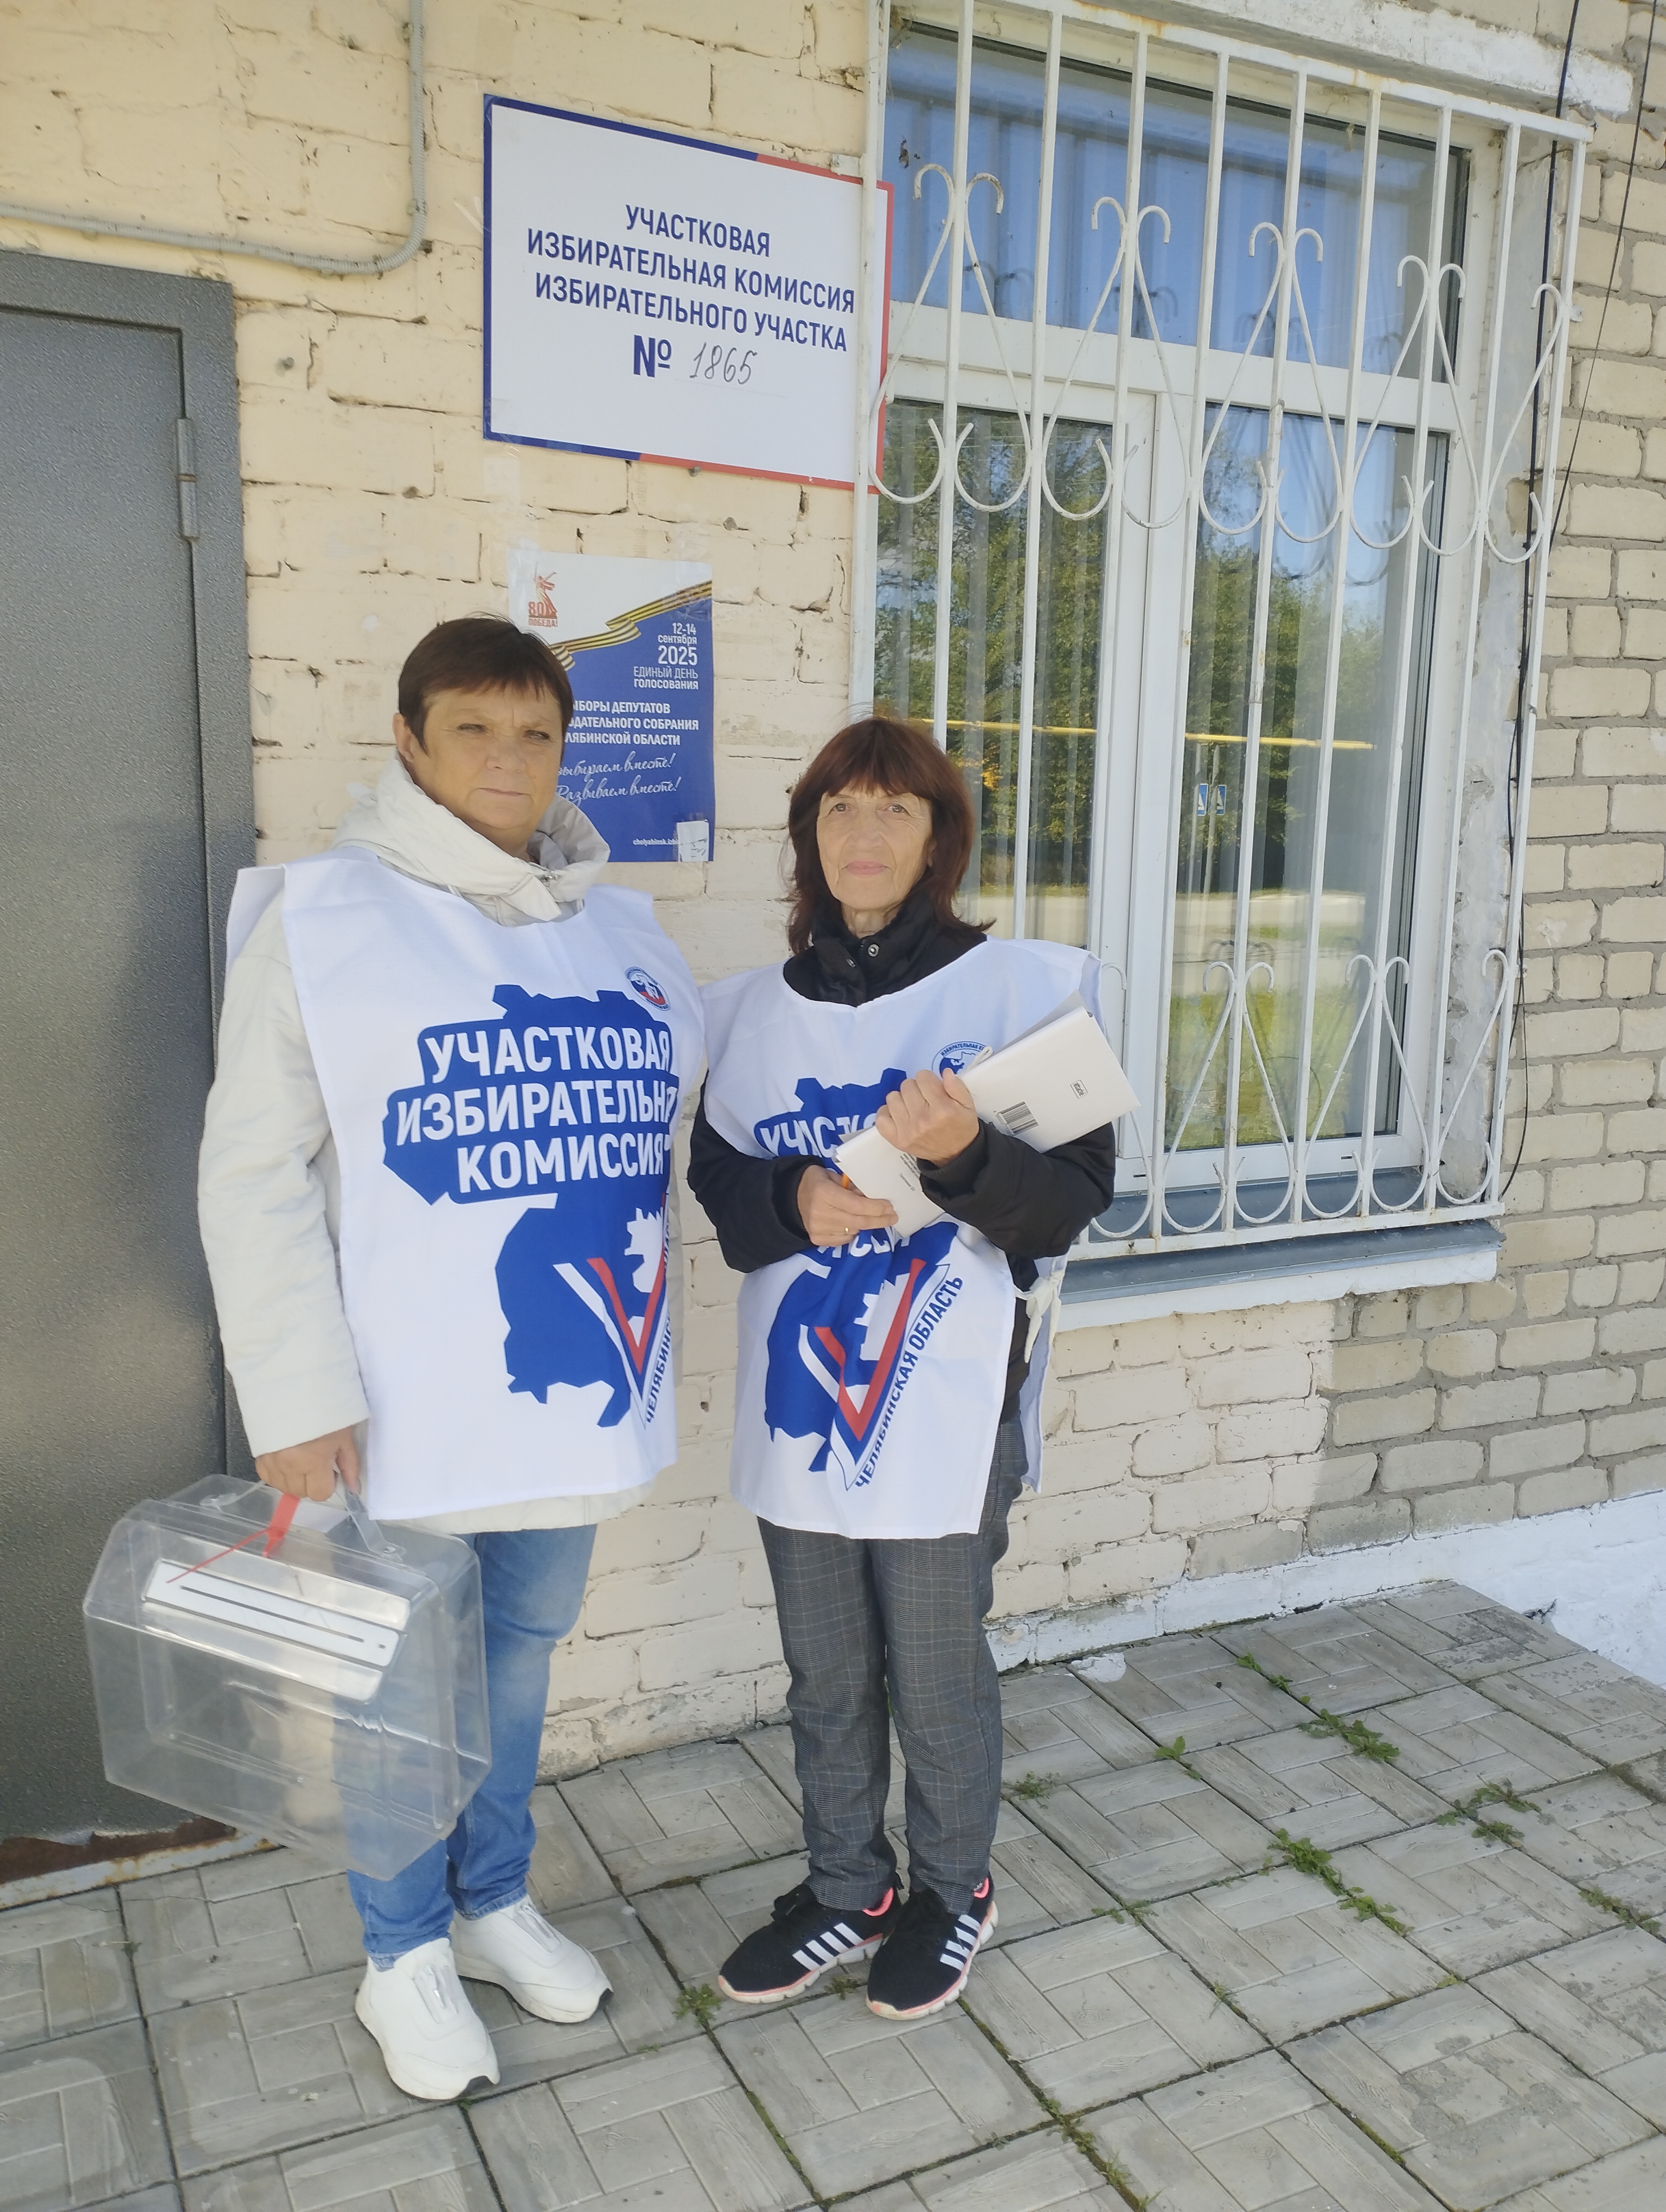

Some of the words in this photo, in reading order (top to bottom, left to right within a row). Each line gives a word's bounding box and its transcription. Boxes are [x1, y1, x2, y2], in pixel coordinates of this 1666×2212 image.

[625, 204, 770, 258] УЧАСТКОВАЯ
[528, 228, 726, 290] ИЗБИРАТЕЛЬНАЯ
[735, 267, 855, 313] КОМИССИЯ
[535, 272, 747, 333] ИЗБИРАТЕЛЬНОГО
[754, 312, 847, 352] УЧАСТКА
[689, 342, 758, 384] 1865
[672, 622, 696, 635] 12-14
[658, 634, 697, 646] сентября
[658, 645, 698, 666] 2025
[633, 666, 672, 678] ЕДИНЫЙ
[674, 668, 699, 679] ДЕНЬ
[573, 700, 610, 712] ЫБОРЫ
[611, 702, 671, 714] ДЕПУТАТОВ
[643, 718, 699, 730] СОБРАНИЯ
[565, 731, 631, 744] ЛЯБИНСКОЙ
[633, 734, 681, 745] ОБЛАСТИ
[558, 760, 624, 782] ыбираем
[424, 1025, 670, 1084] УЧАСТКОВАЯ
[457, 1133, 664, 1194] КОМИССИЯ
[855, 1350, 919, 1488] ЧЕЛЯБИНСКАЯ
[909, 1276, 964, 1351] ОБЛАСТЬ
